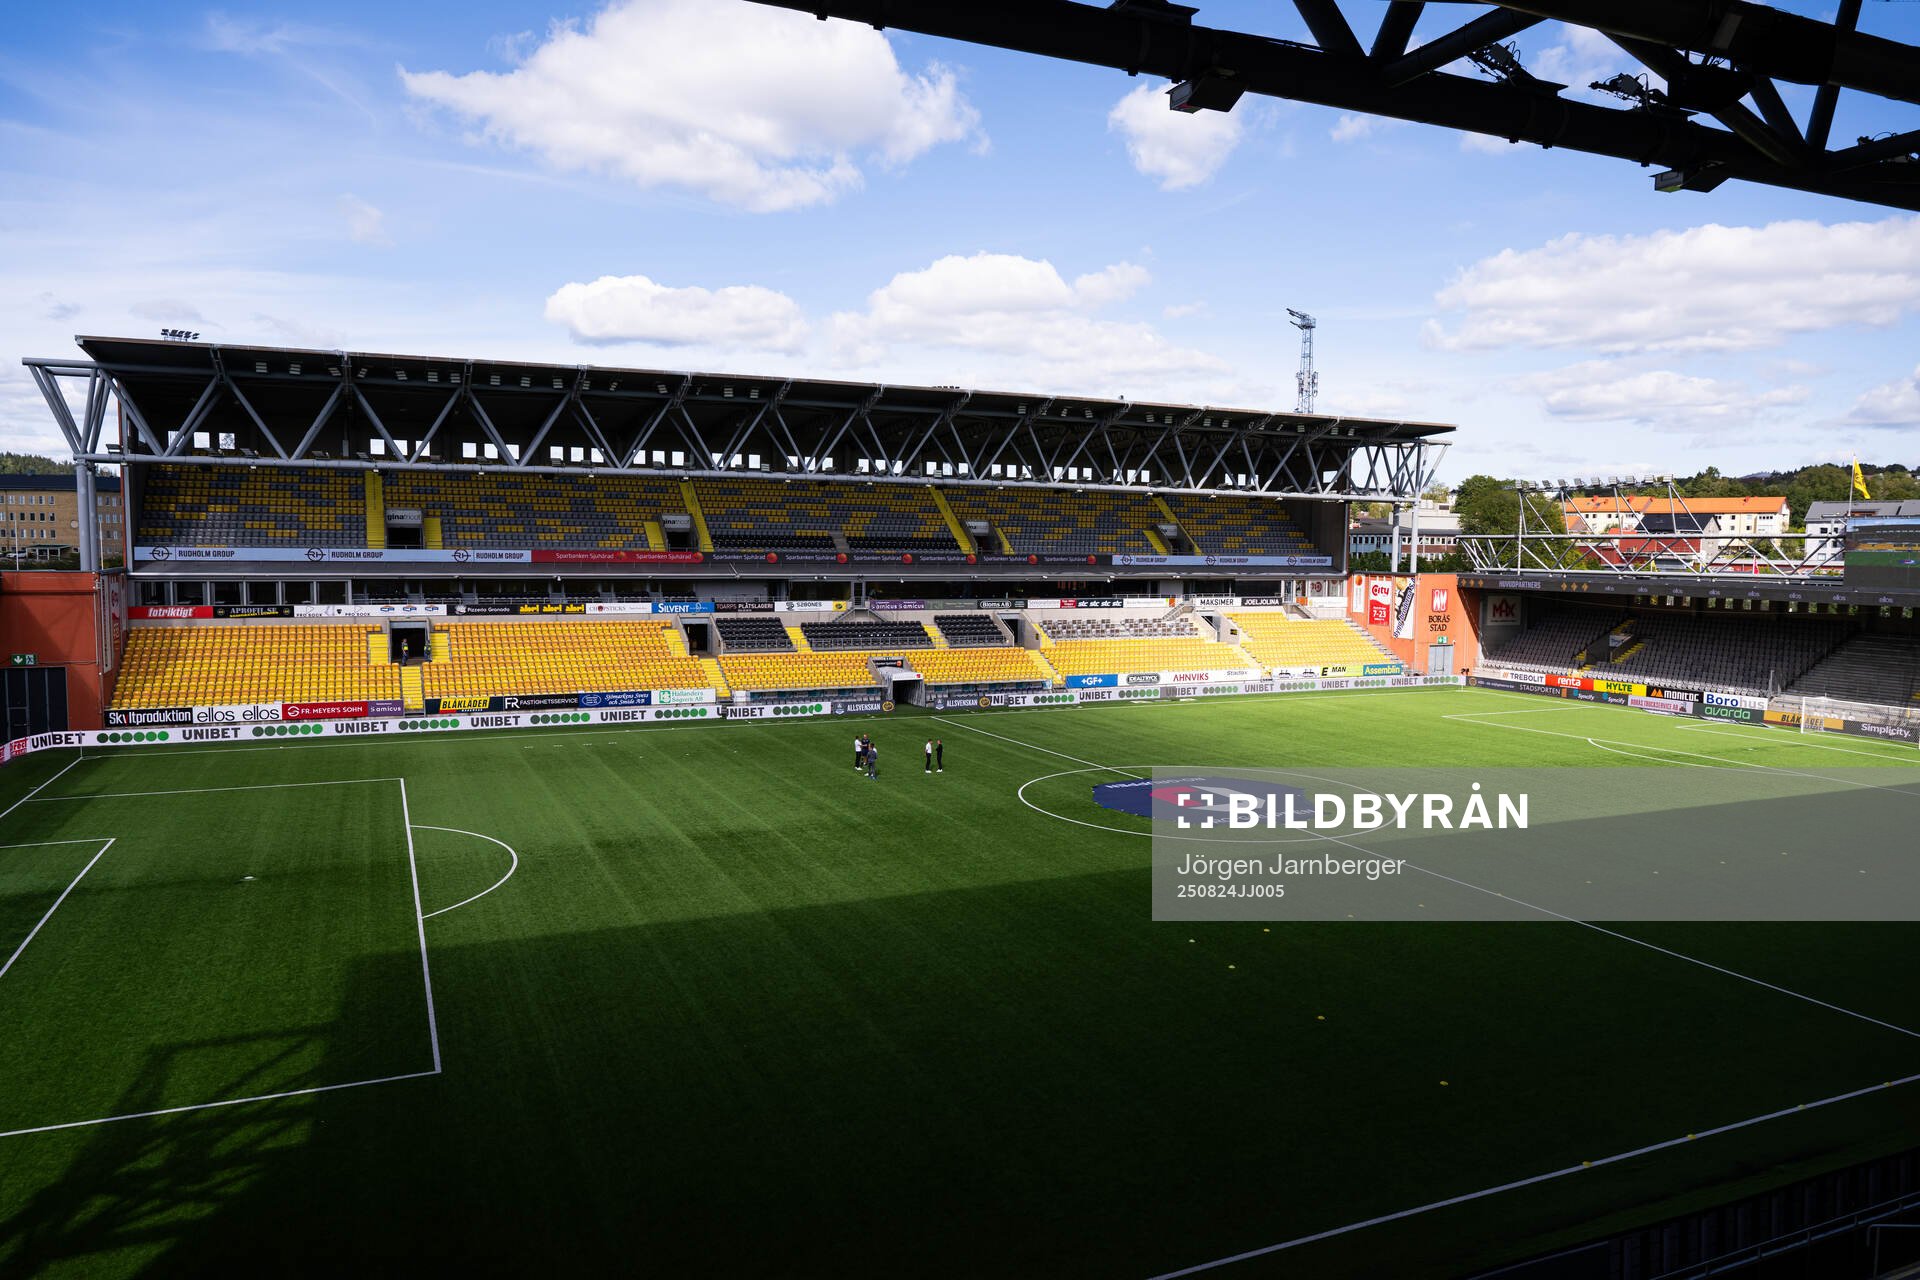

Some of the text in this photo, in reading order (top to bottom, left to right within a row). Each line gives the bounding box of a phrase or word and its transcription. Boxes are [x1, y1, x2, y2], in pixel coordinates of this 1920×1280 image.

[178, 550, 235, 558] RUDHOLM GROUP
[331, 551, 384, 559] RUDHOLM GROUP
[476, 552, 524, 560] RUDHOLM GROUP
[1200, 598, 1234, 606] MAKSIMER
[1428, 614, 1450, 623] BORÅS
[1364, 665, 1400, 675] Assemblin
[1173, 673, 1209, 682] AHNVIKS
[1391, 677, 1418, 685] UNIBET
[1510, 672, 1544, 682] TREBOLIT
[1557, 677, 1581, 686] renta
[1244, 683, 1274, 692] UNIBET
[1321, 680, 1349, 688] UNIBET
[1606, 682, 1632, 692] HYLTE
[1079, 691, 1112, 700] UNIBET
[1166, 687, 1197, 696] UNIBET
[442, 698, 488, 709] BLÅKLÄDER
[505, 697, 521, 709] FR
[847, 702, 881, 711] ALLSVENSKAN
[946, 698, 977, 707] ALLSVENSKAN
[243, 705, 280, 720] ellos
[342, 705, 363, 713] SOHN
[1704, 706, 1751, 720] avarda
[197, 707, 235, 722] ellos
[600, 710, 647, 721] UNIBET
[471, 715, 520, 727] UNIBET
[335, 721, 388, 734] UNIBET
[182, 727, 240, 740] UNIBET
[32, 733, 85, 748] UNIBET
